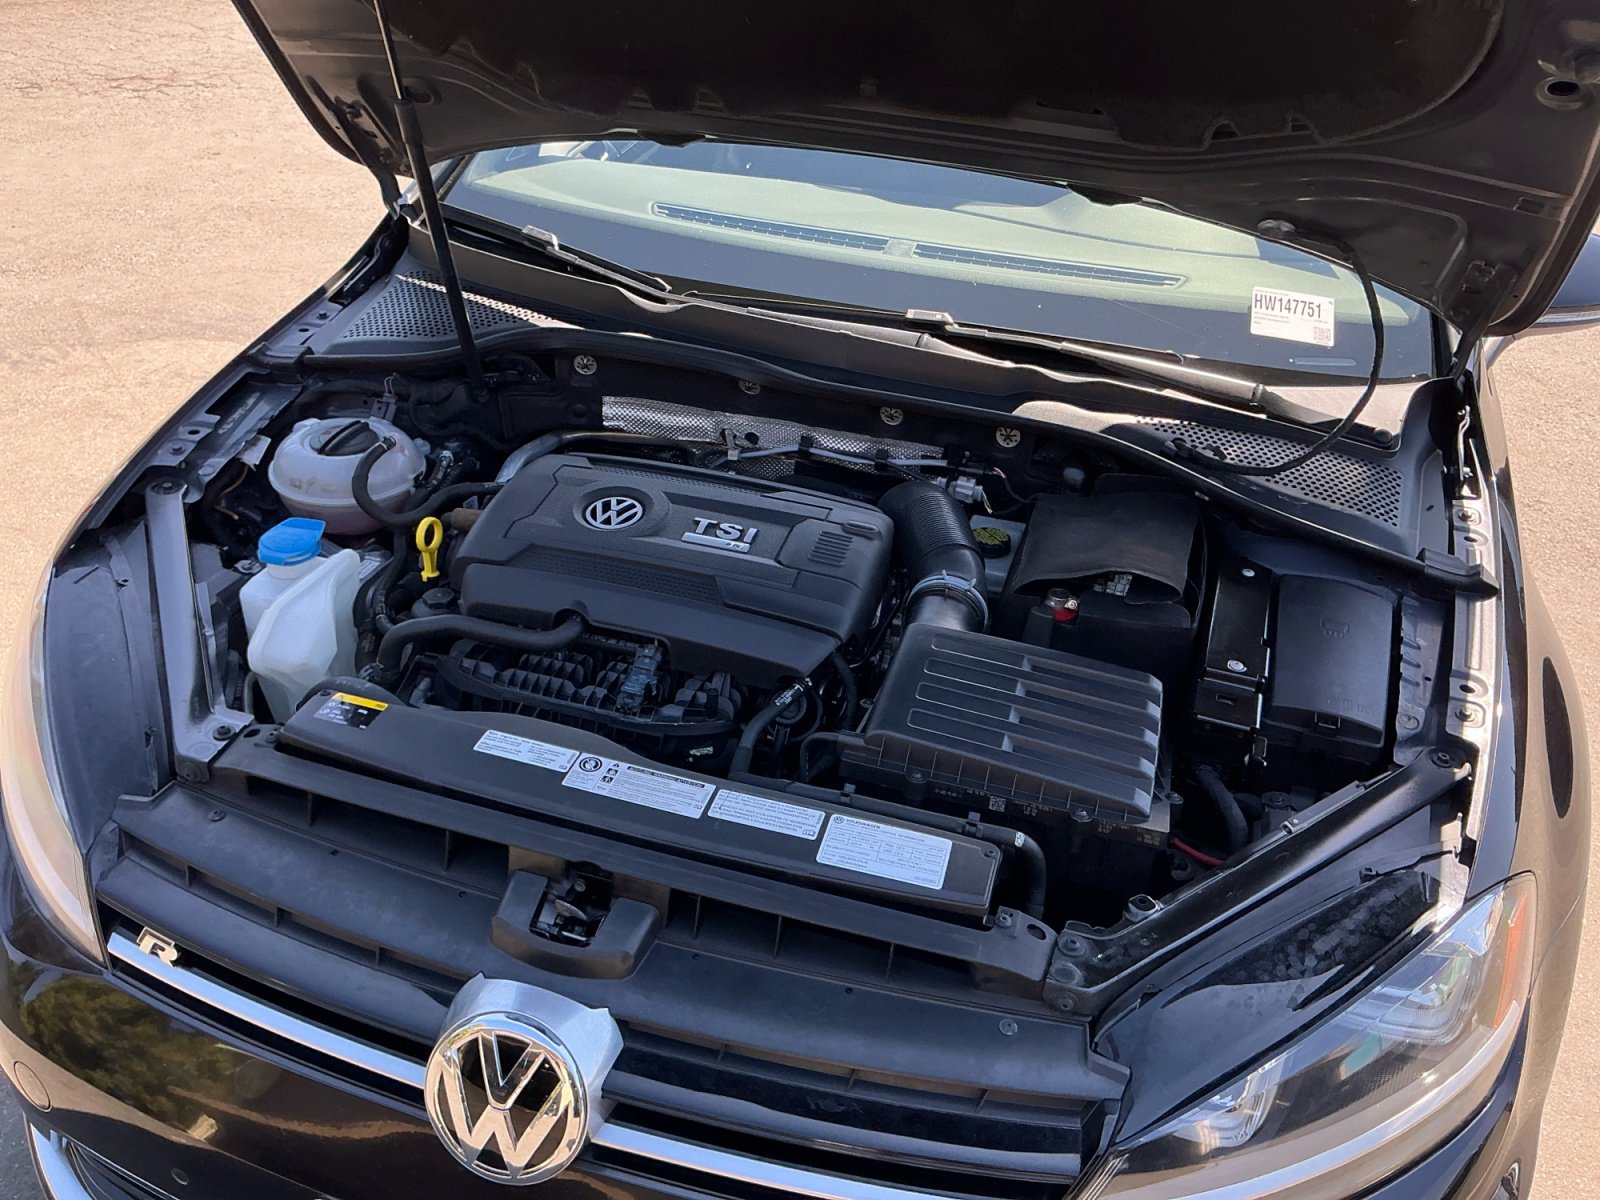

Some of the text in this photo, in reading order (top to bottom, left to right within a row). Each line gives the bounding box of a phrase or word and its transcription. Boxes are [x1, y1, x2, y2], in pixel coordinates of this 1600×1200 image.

[1254, 293, 1322, 319] HW147751
[585, 496, 643, 530] VW
[693, 516, 759, 544] TSI
[845, 818, 880, 829] VOLKSWAGEN
[137, 928, 178, 968] R
[425, 1010, 590, 1186] VW
